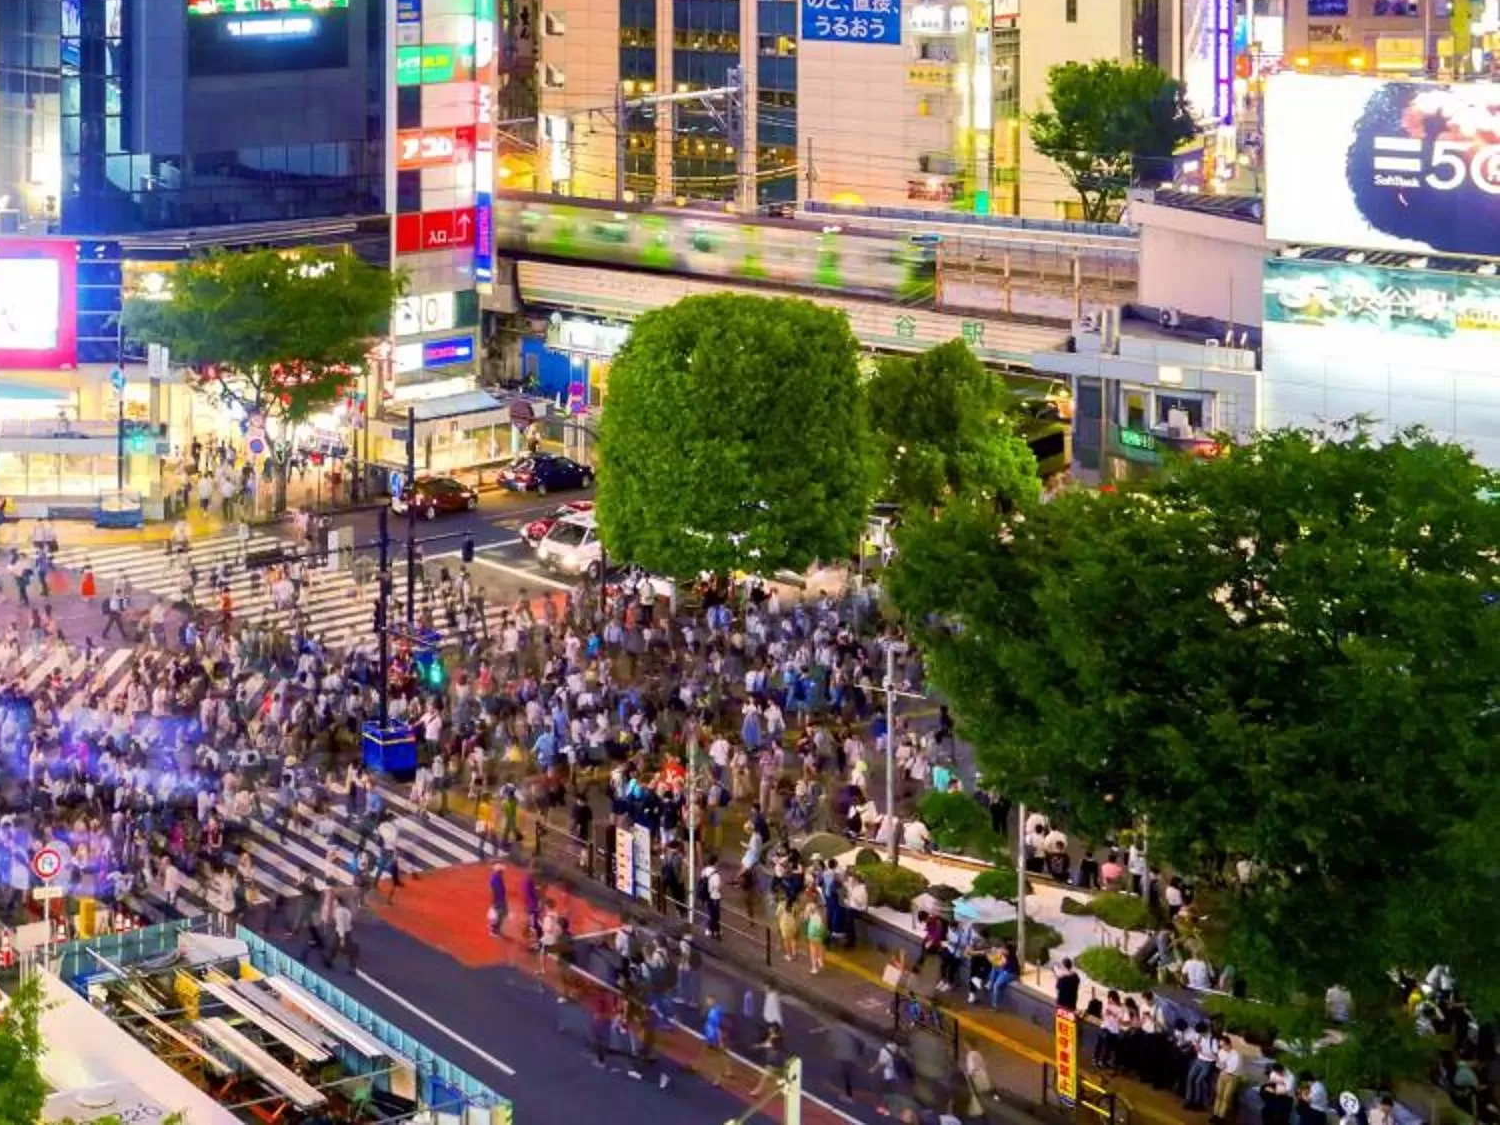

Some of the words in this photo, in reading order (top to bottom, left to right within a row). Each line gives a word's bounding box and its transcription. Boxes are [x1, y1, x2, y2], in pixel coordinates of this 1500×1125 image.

[815, 15, 885, 38] うるおう
[428, 229, 448, 245] 入口
